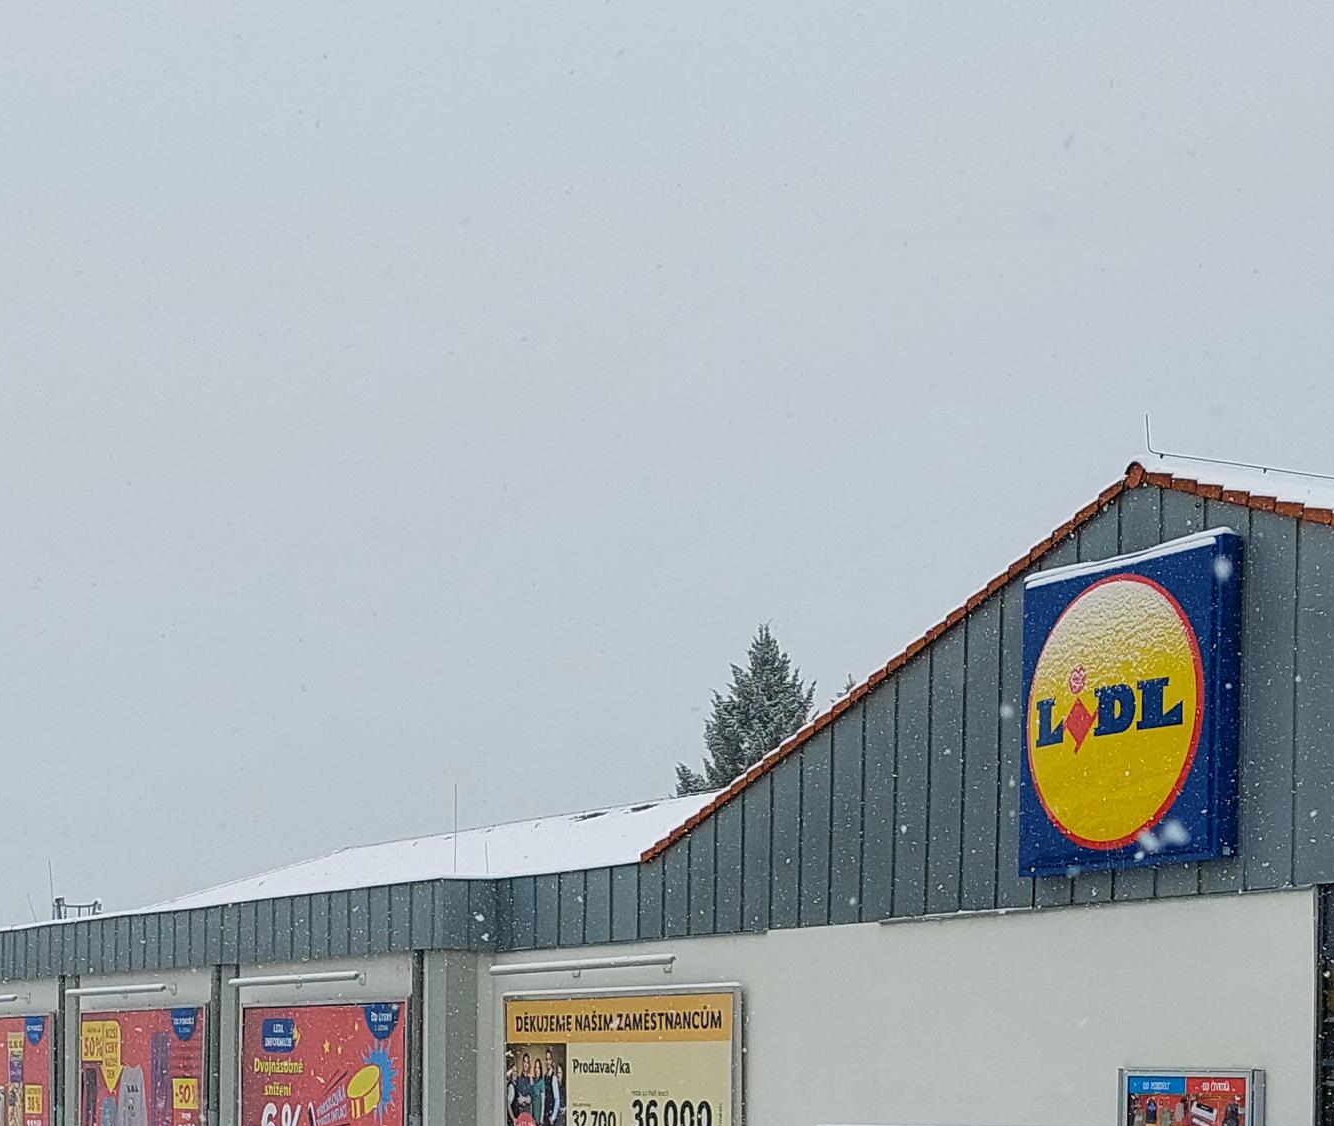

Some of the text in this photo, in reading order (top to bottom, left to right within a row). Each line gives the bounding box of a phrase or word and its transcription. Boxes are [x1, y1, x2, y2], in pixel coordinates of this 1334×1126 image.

[515, 1011, 572, 1033] DĚKUJEME
[616, 1005, 723, 1031] ZAMĚSTNANCŮM
[572, 1056, 631, 1078] Prodavač/ka
